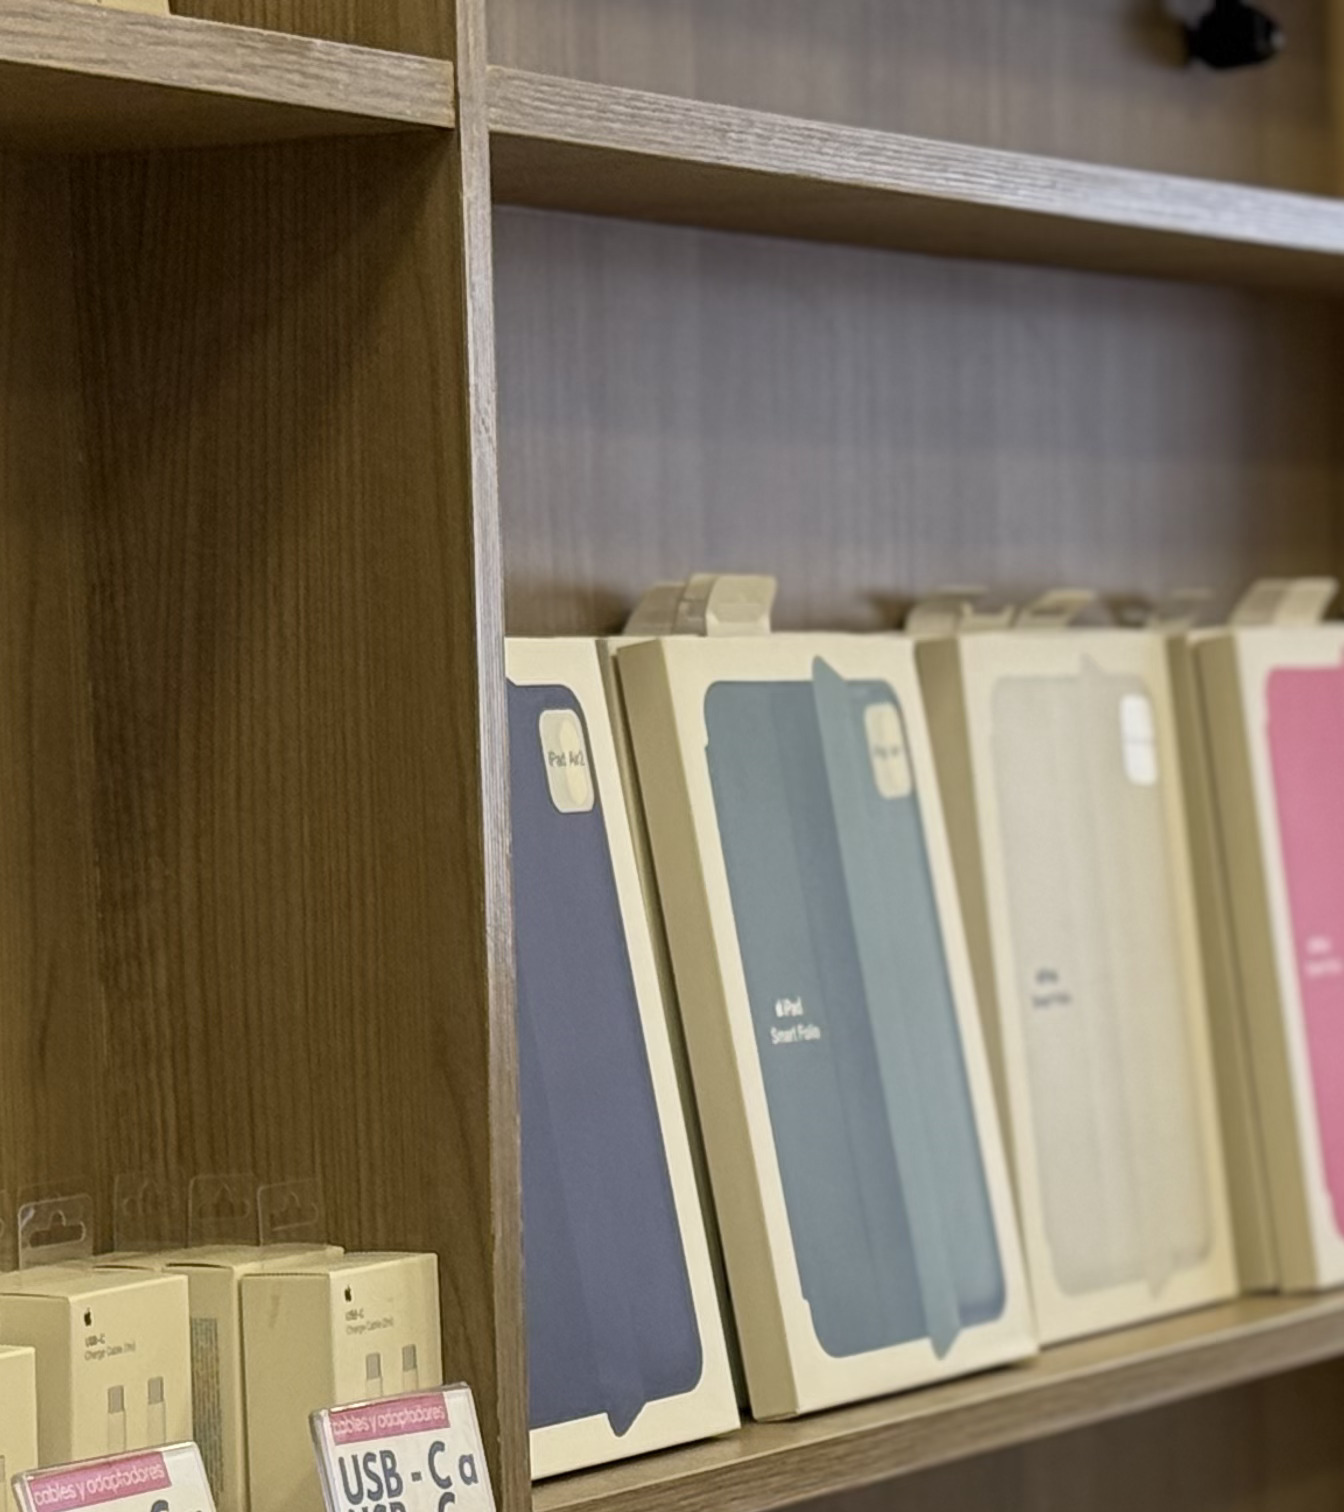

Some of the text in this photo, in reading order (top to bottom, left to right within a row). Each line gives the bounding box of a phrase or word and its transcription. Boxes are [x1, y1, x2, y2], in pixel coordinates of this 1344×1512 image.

[333, 1404, 446, 1436] cables y adaptadores
[35, 1462, 166, 1506] cables y adaptadores
[338, 1450, 404, 1505] USB
[428, 1441, 453, 1490] C
[458, 1453, 479, 1486] a
